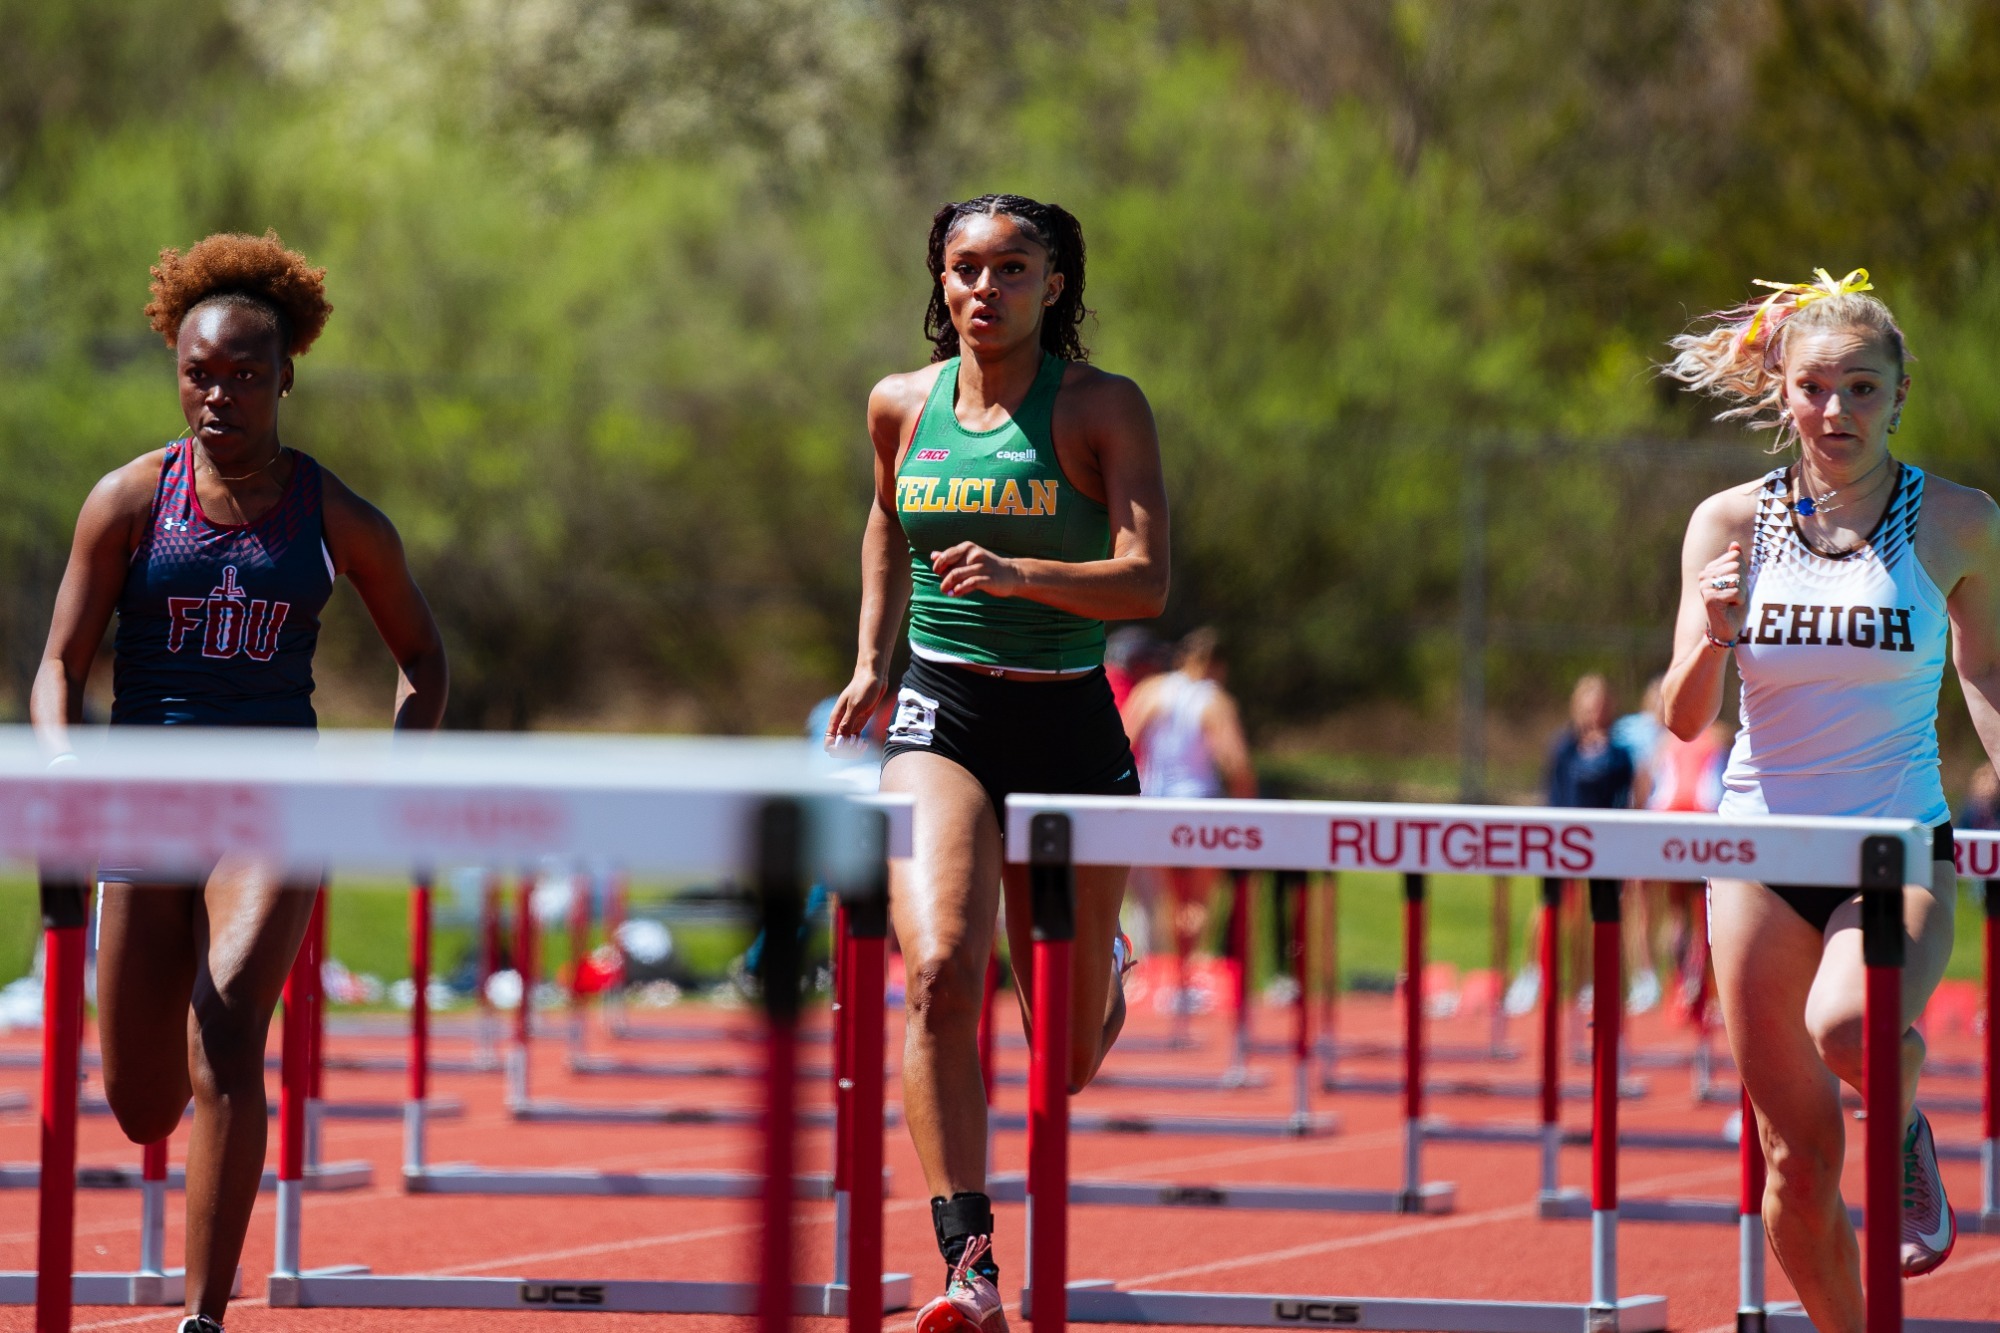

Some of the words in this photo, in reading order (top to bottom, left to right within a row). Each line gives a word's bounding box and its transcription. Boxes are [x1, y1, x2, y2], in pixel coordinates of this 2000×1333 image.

[917, 449, 949, 461] CACC
[996, 449, 1036, 461] capelli
[167, 597, 290, 661] FDU
[1199, 826, 1263, 851] UCS
[1329, 819, 1595, 873] RUTGERS
[1692, 838, 1757, 864] UCS
[521, 1284, 605, 1304] UCS
[1275, 1302, 1360, 1323] UCS
